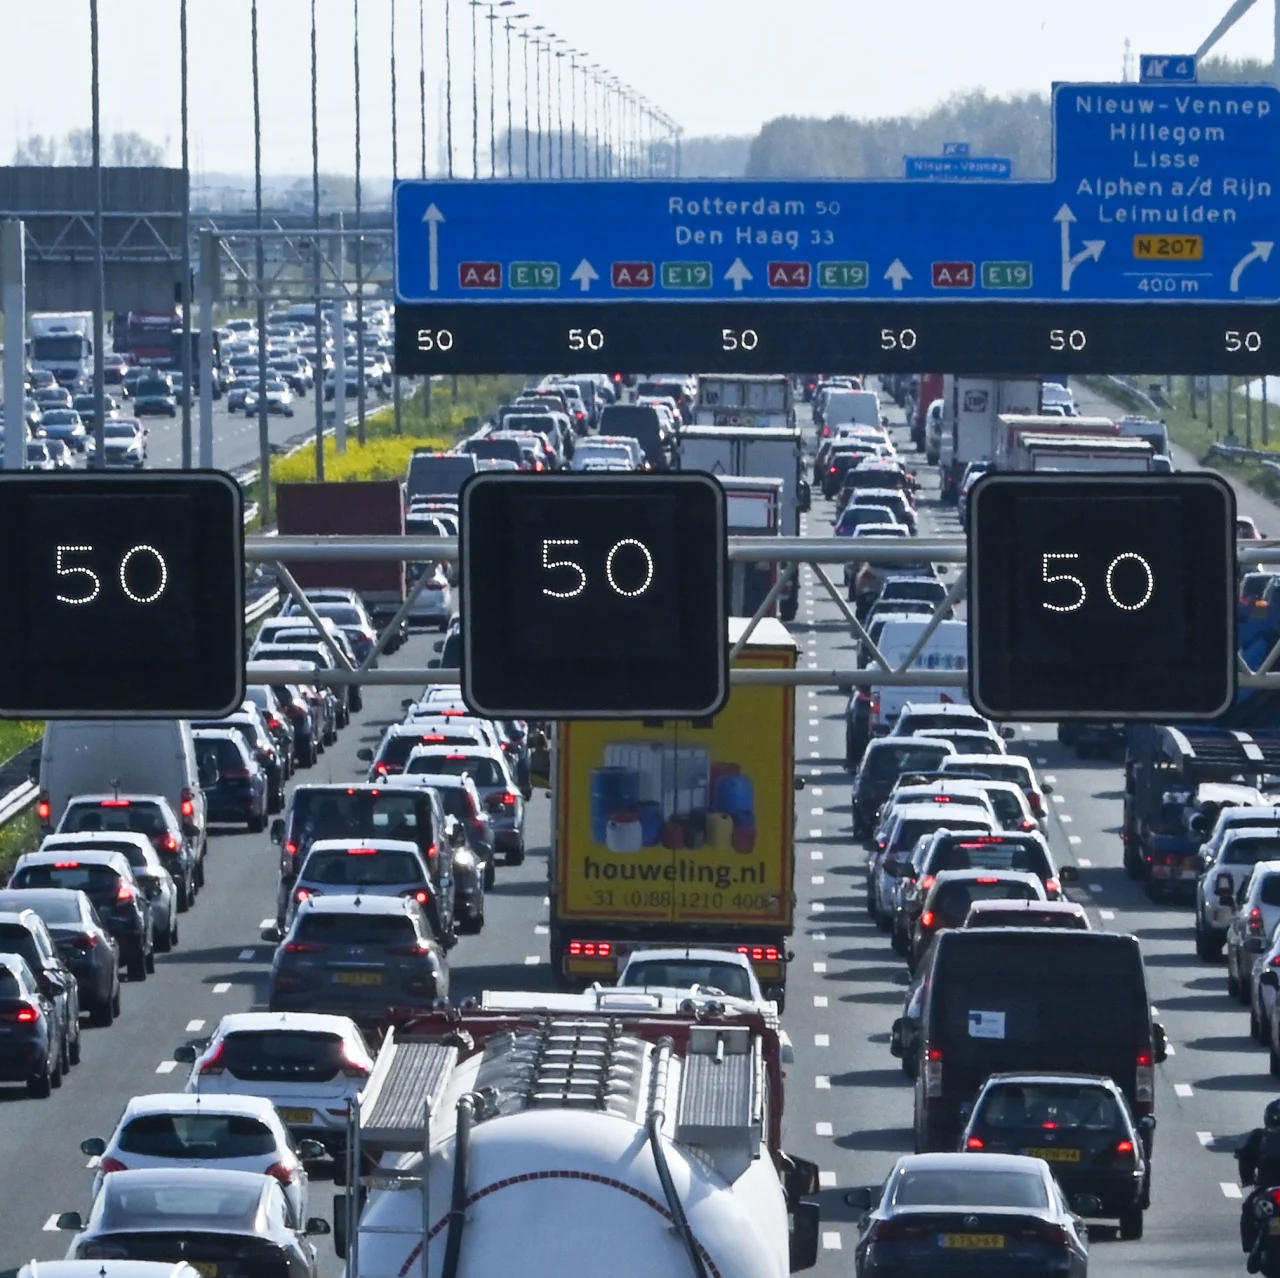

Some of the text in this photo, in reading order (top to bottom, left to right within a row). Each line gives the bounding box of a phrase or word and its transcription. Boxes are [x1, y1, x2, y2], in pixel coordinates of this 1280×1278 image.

[1175, 62, 1188, 76] 4
[1075, 96, 1272, 119] Nieuw-Vennep
[1109, 123, 1226, 147] Hillegom
[1133, 151, 1200, 168] Lisse
[1076, 177, 1272, 201] Alphen a/d Rijn
[668, 196, 841, 215] Rotterdam 50
[1099, 204, 1237, 222] Leimuiden
[675, 225, 835, 249] Den Haag 33
[464, 267, 496, 283] A4
[516, 267, 554, 283] E19
[617, 267, 650, 283] A4
[668, 267, 707, 283] E19
[773, 267, 806, 283] A4
[824, 267, 863, 283] E19
[937, 267, 970, 283] A4
[988, 267, 1027, 283] E19
[1137, 279, 1199, 292] 400 m
[417, 329, 454, 351] 50
[567, 328, 605, 350] 50
[721, 329, 759, 351] 50
[880, 329, 917, 350] 50
[1049, 329, 1087, 351] 50
[1224, 330, 1262, 352] 50
[55, 544, 168, 605] 50
[541, 538, 655, 598] 50
[1042, 553, 1155, 612] 50
[583, 856, 766, 890] houweling.nl
